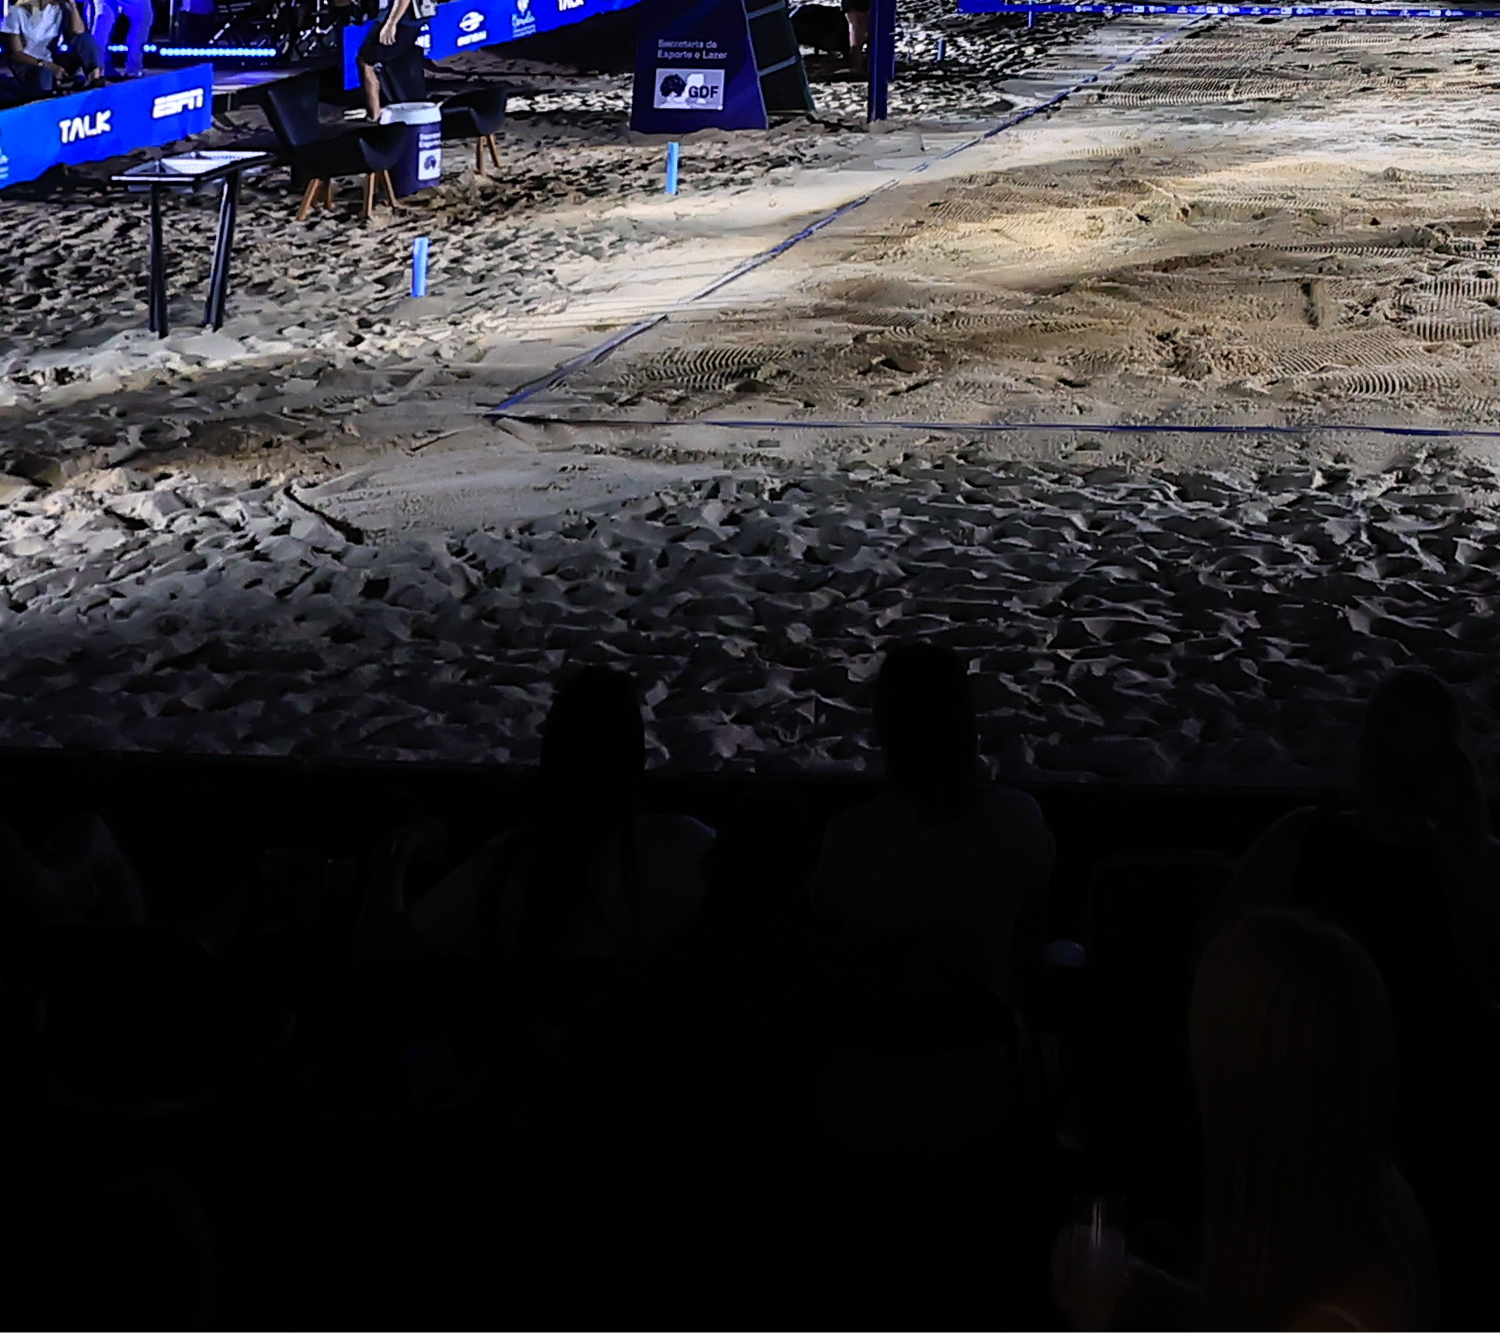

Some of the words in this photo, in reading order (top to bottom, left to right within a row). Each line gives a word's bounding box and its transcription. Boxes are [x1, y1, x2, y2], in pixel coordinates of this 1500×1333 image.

[152, 88, 204, 119] ESPN
[688, 85, 719, 99] GDF
[59, 109, 112, 144] TALK
